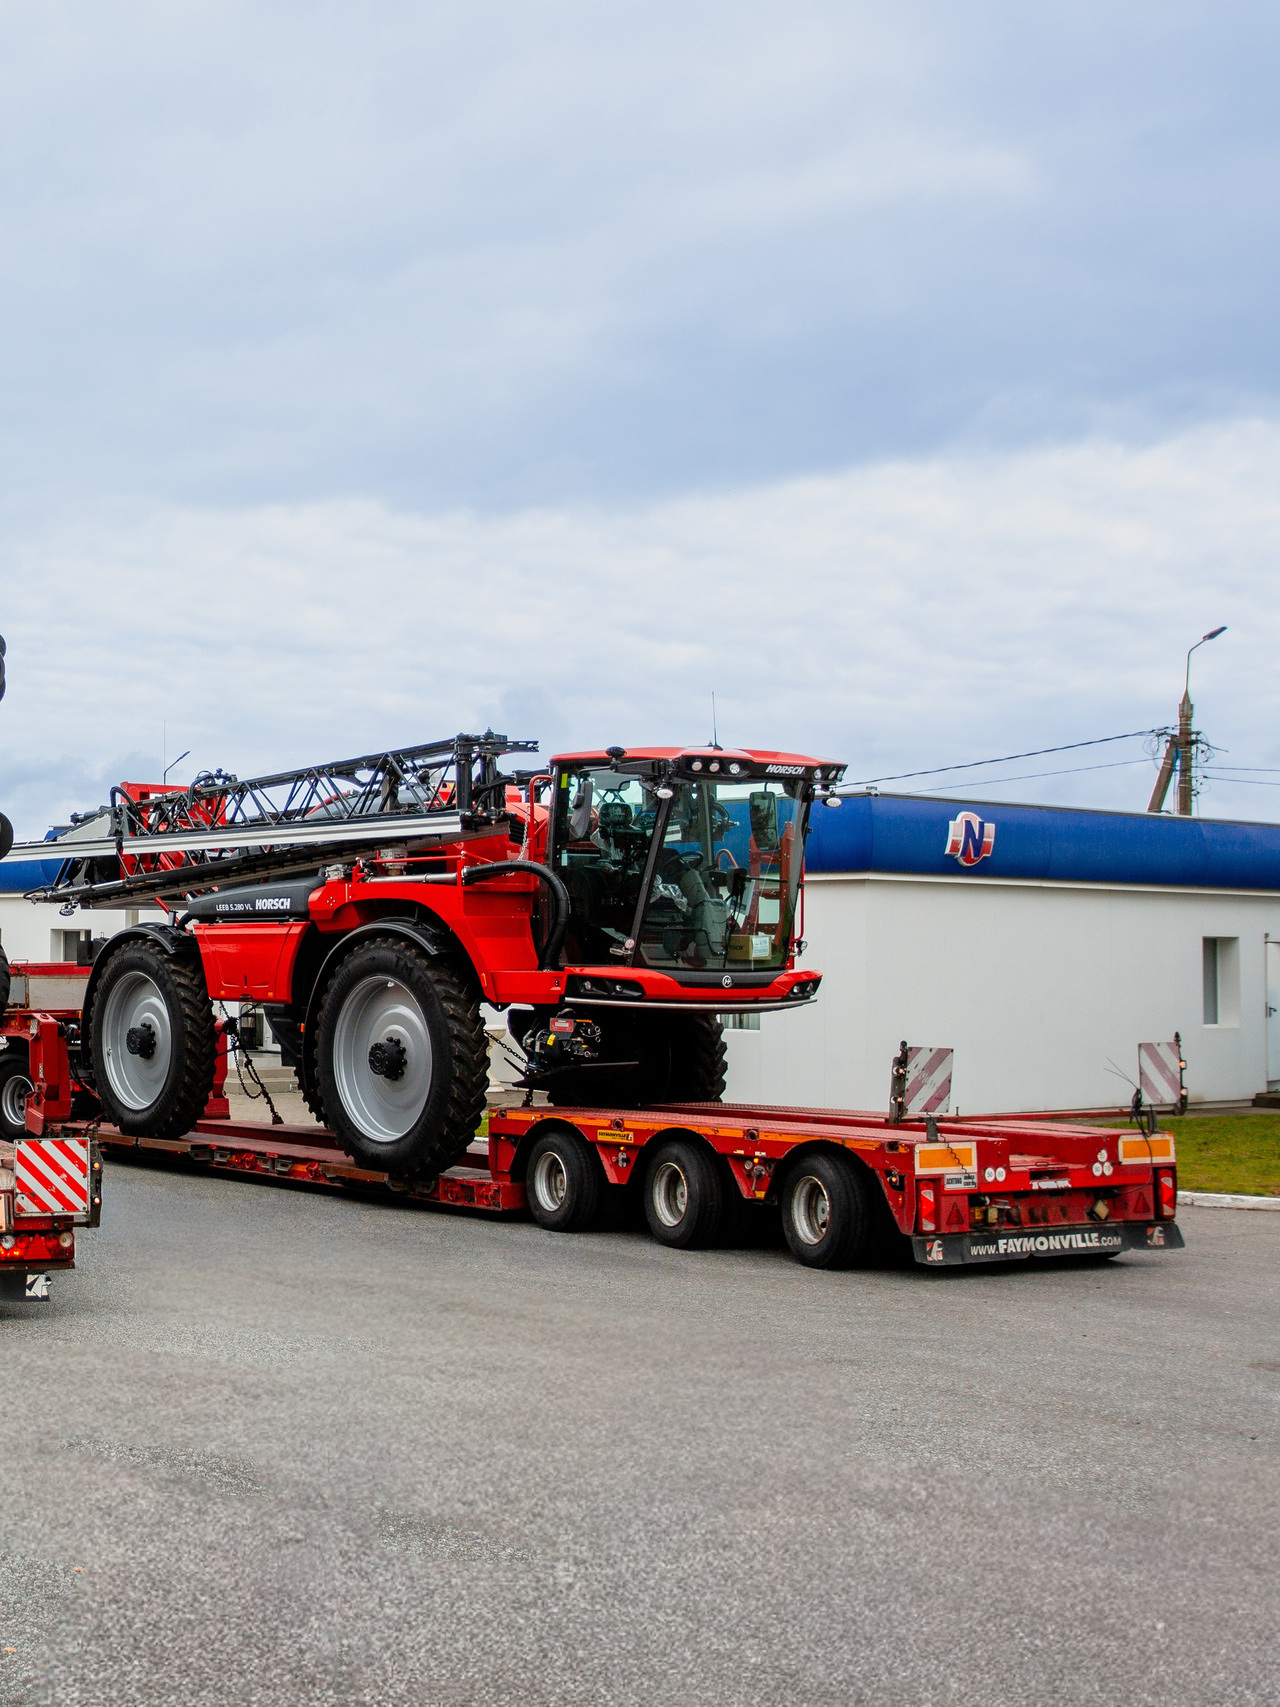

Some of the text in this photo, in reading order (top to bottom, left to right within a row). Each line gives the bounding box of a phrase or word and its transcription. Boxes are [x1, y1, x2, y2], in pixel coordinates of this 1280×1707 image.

[765, 765, 805, 775] HORSCH
[230, 903, 245, 911] S.280
[255, 898, 291, 910] HORSCH
